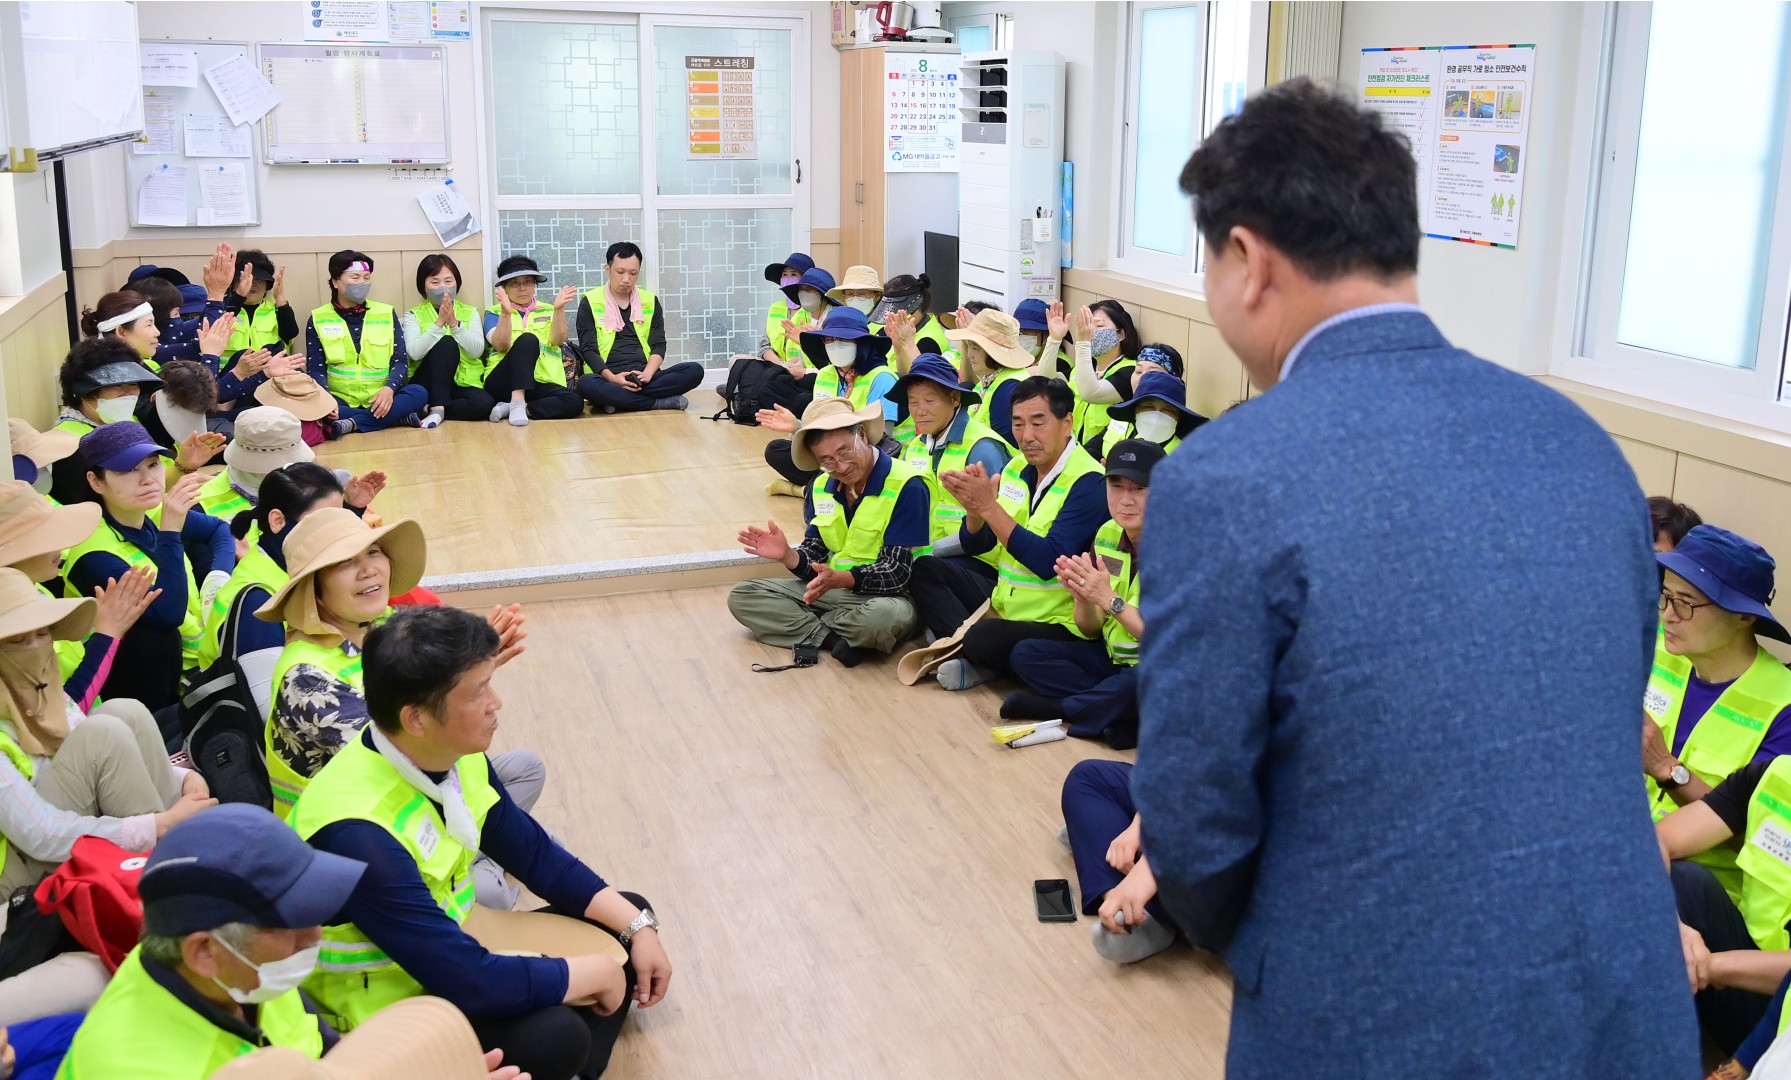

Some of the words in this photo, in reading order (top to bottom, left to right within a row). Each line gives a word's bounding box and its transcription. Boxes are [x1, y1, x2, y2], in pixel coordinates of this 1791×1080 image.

[714, 59, 748, 68] 스트레칭
[919, 60, 927, 72] 8
[1457, 65, 1472, 73] 공무직
[1473, 65, 1483, 73] 가로
[1496, 65, 1527, 73] 안전보건수칙
